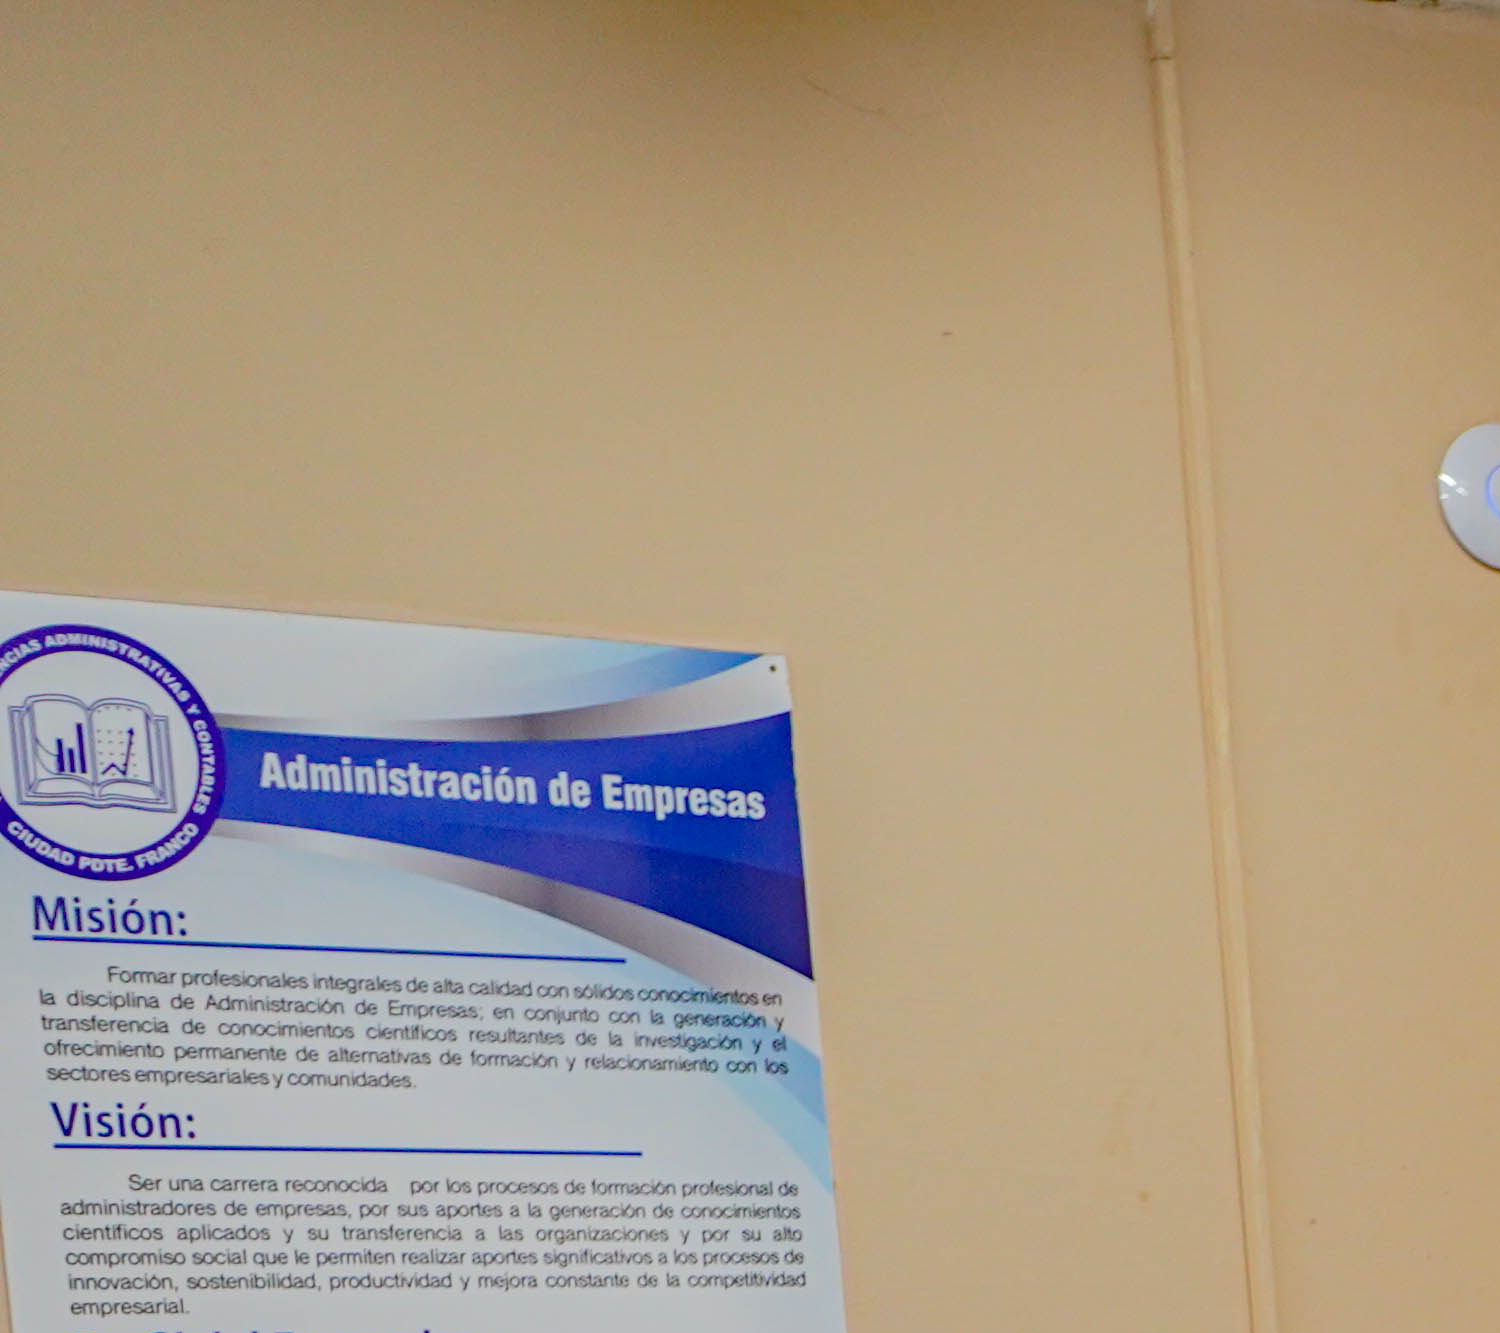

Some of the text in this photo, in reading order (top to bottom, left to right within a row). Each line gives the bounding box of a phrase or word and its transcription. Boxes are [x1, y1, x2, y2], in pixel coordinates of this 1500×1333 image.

[44, 633, 190, 703] ADMINISTRATIVAS
[186, 703, 201, 715] Y
[193, 719, 216, 815] CONTABLES
[259, 751, 766, 821] Administración de Empresas
[7, 820, 76, 866] CIUDAD
[134, 822, 200, 870] FRANCO
[32, 895, 187, 937] Misión:
[106, 967, 782, 1008] Formar profesionales integrales de alta calidad con sólidos conocimientos en
[46, 1065, 416, 1090] sectores empresariales y comunidades.
[50, 1101, 196, 1139] Visión:
[128, 1174, 798, 1200] Ser una carrera reconocida por los procesos de formación profesional de
[69, 1297, 189, 1319] empresarial.
